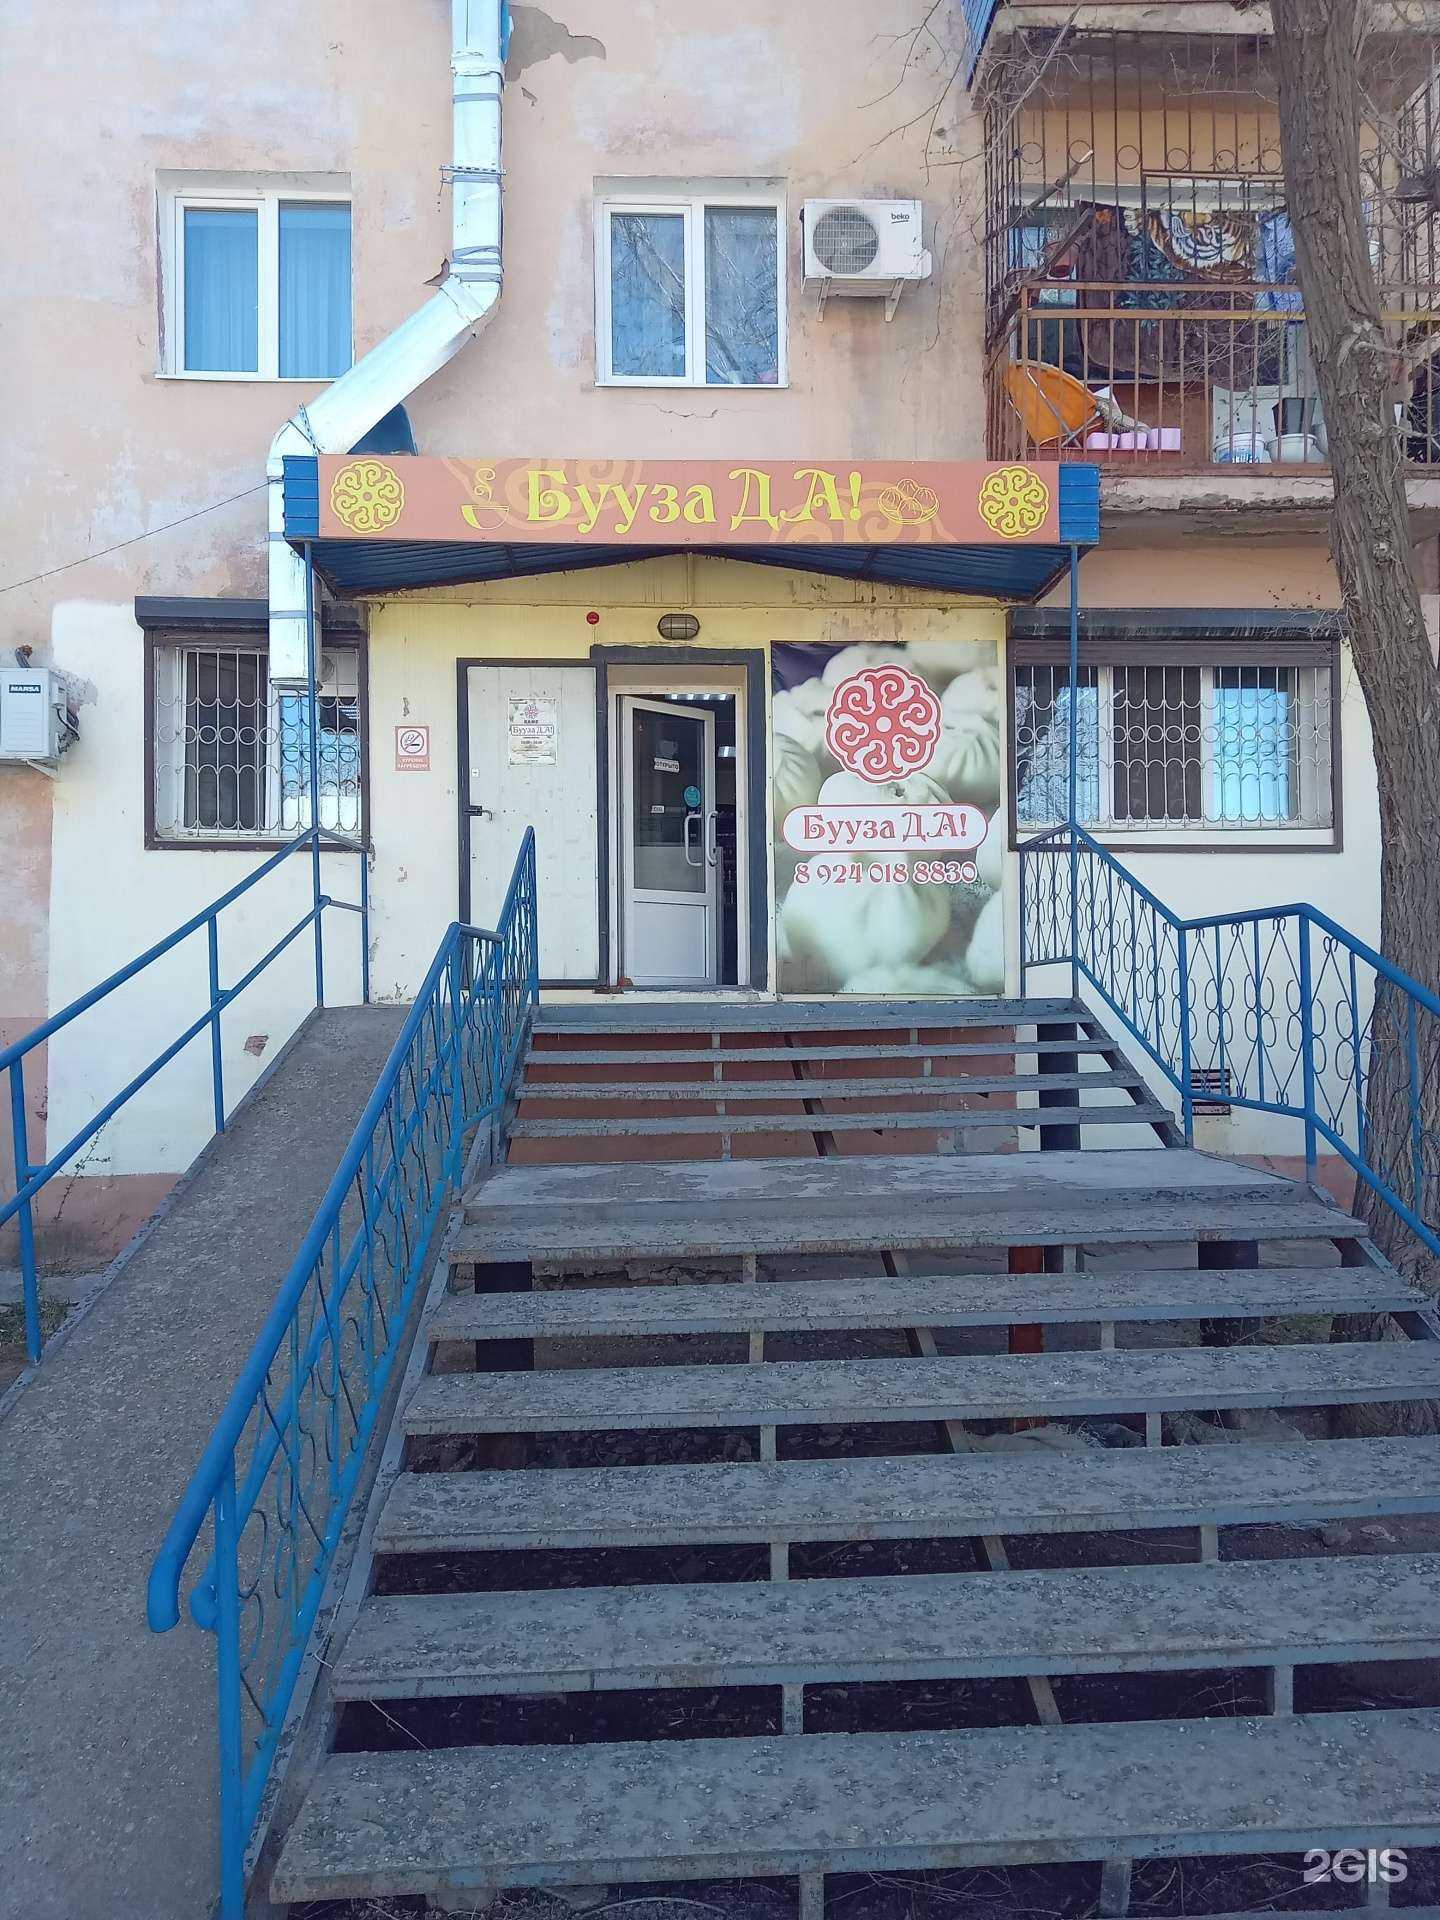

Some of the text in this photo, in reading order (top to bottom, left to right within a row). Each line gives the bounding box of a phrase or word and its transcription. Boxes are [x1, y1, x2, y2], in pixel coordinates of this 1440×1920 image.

[526, 468, 863, 534] Бууза ДА!
[803, 812, 967, 845] Бууза ДА!
[795, 861, 978, 885] 8 924 018 8830
